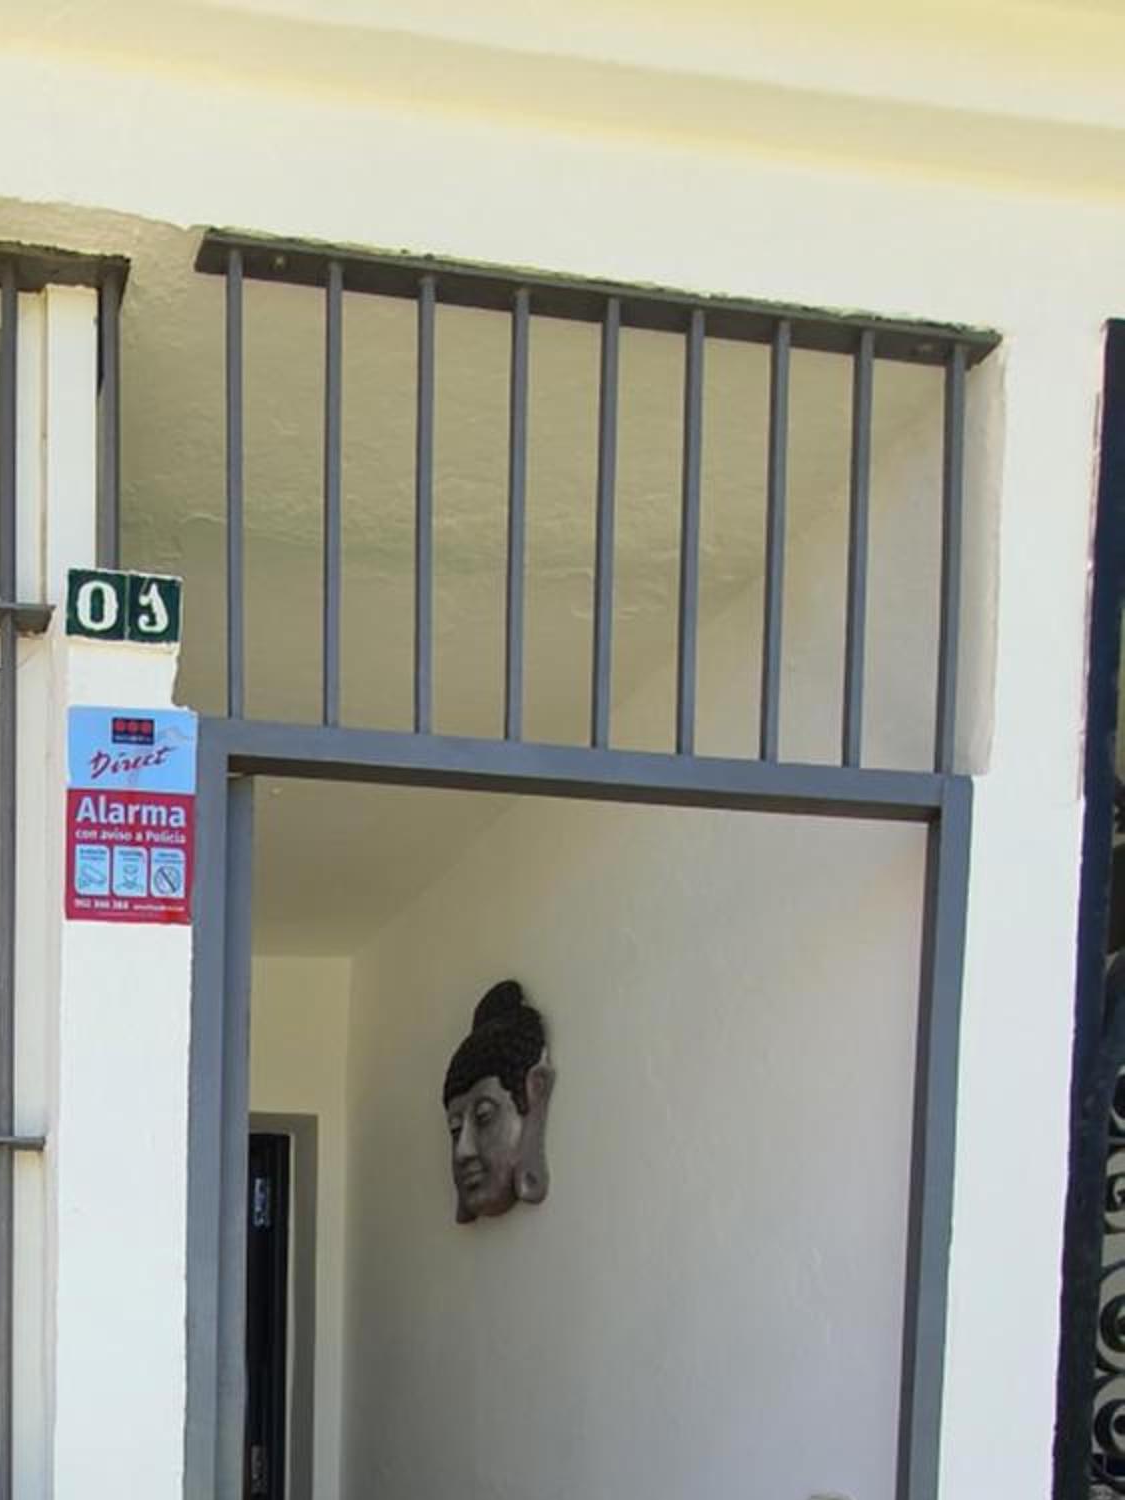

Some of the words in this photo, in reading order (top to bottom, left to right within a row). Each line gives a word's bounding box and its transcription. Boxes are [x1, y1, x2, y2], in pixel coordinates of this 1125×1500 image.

[90, 747, 177, 780] Direct
[75, 795, 186, 828] Alarma
[75, 829, 97, 840] con
[100, 828, 132, 841] aviso
[135, 832, 144, 842] a
